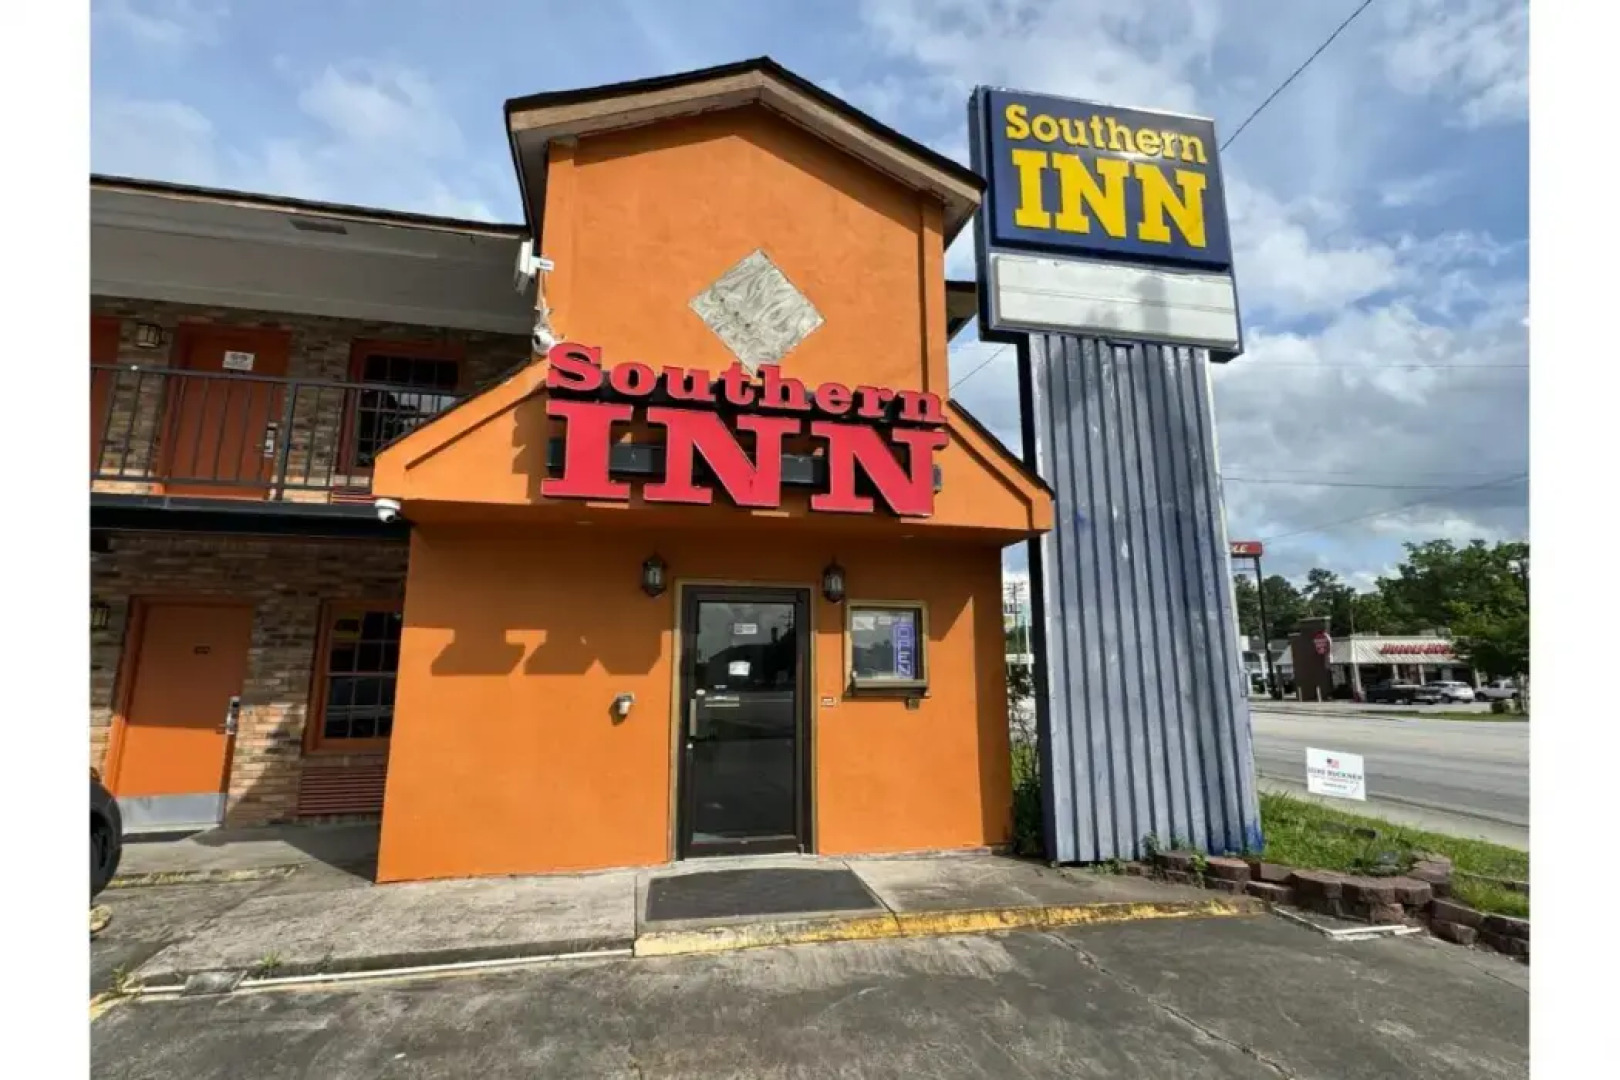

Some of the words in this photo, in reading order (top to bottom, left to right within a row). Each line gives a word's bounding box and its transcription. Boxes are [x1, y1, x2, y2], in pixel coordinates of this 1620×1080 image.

[1005, 103, 1208, 164] Southern
[1012, 149, 1206, 248] INN
[545, 342, 948, 424] Southern
[541, 401, 950, 516] INN
[897, 627, 911, 675] OPEN
